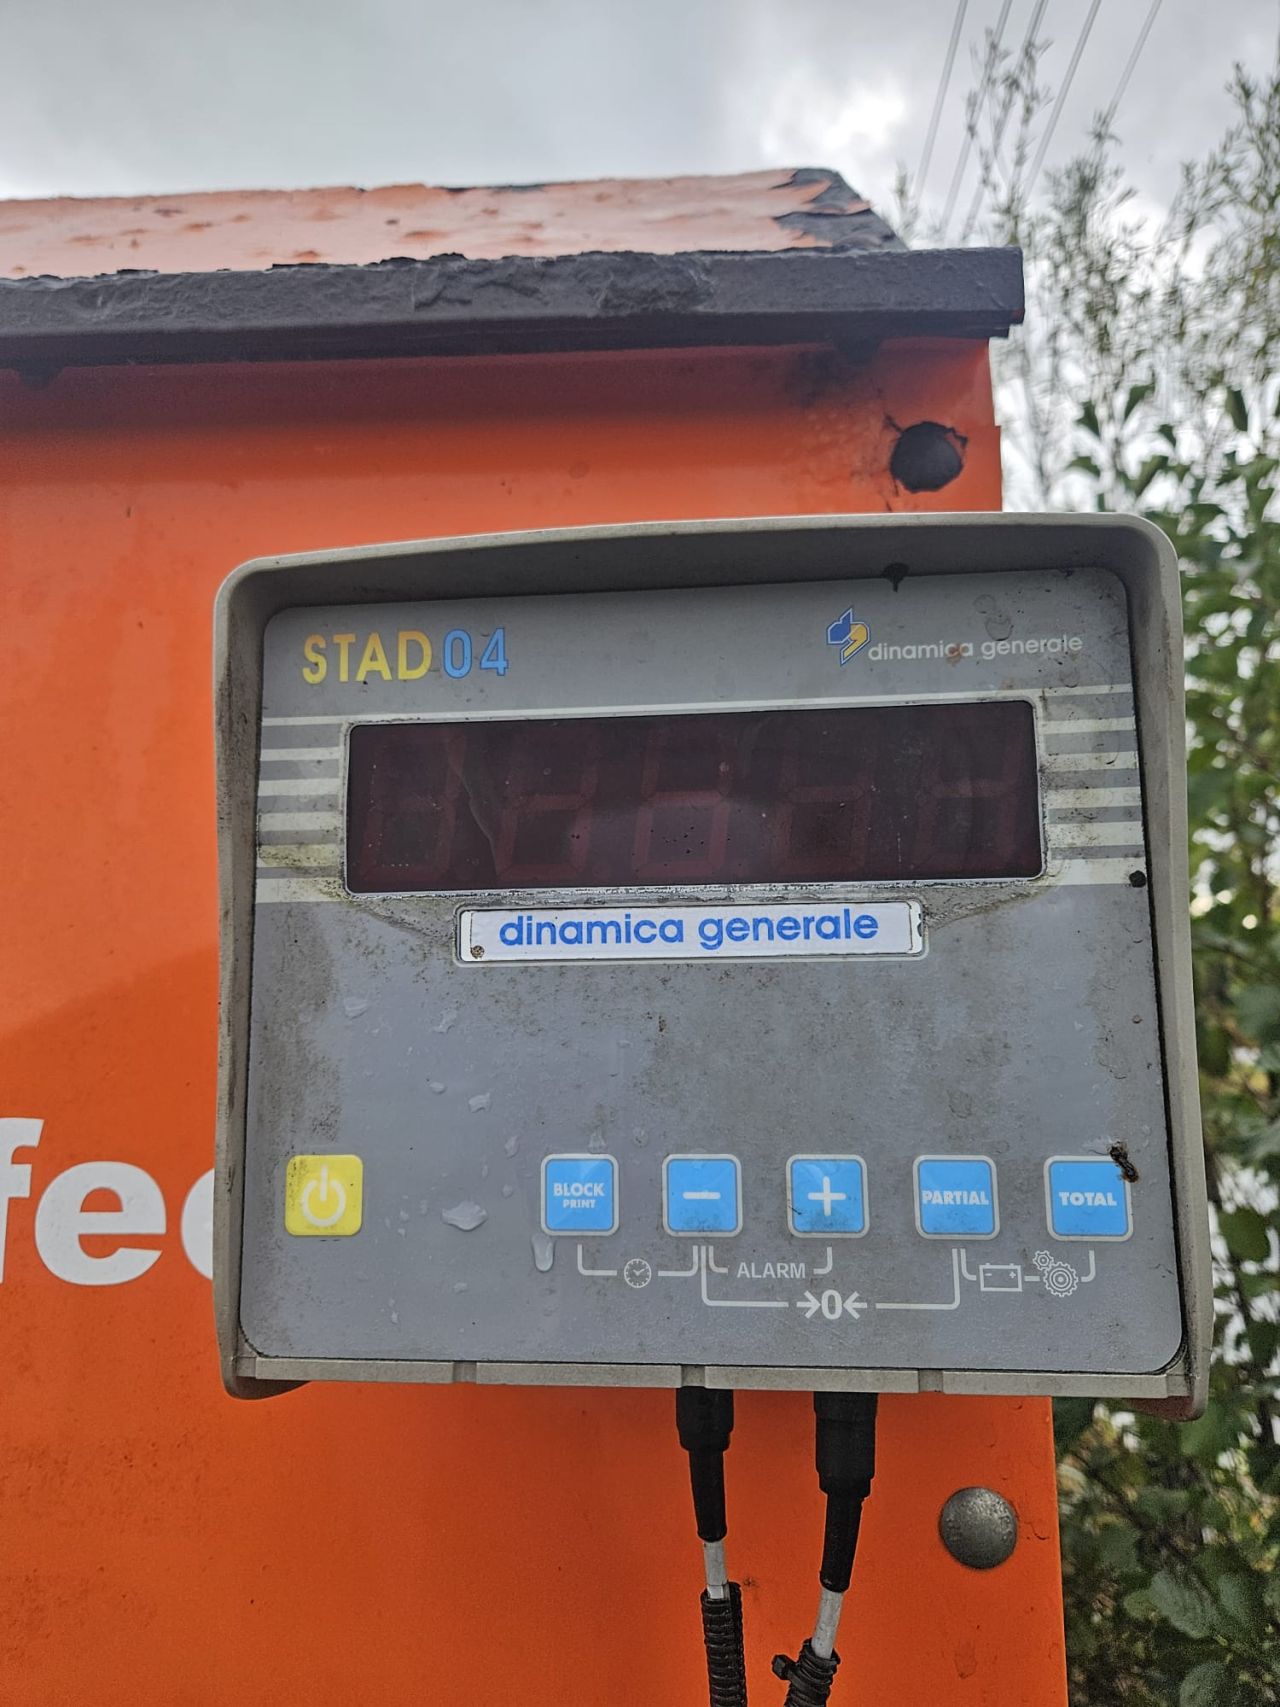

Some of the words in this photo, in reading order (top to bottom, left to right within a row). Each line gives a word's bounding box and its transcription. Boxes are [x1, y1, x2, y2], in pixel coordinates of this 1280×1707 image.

[868, 641, 975, 662] dinamica
[981, 634, 1083, 659] generale
[499, 912, 684, 947] dinamica
[698, 908, 879, 951] generale
[553, 1182, 605, 1197] BLOCK
[563, 1199, 596, 1209] PRINT
[921, 1190, 989, 1206] PARTIAL
[1058, 1191, 1117, 1207] TOTAL
[736, 1262, 806, 1279] ALARM
